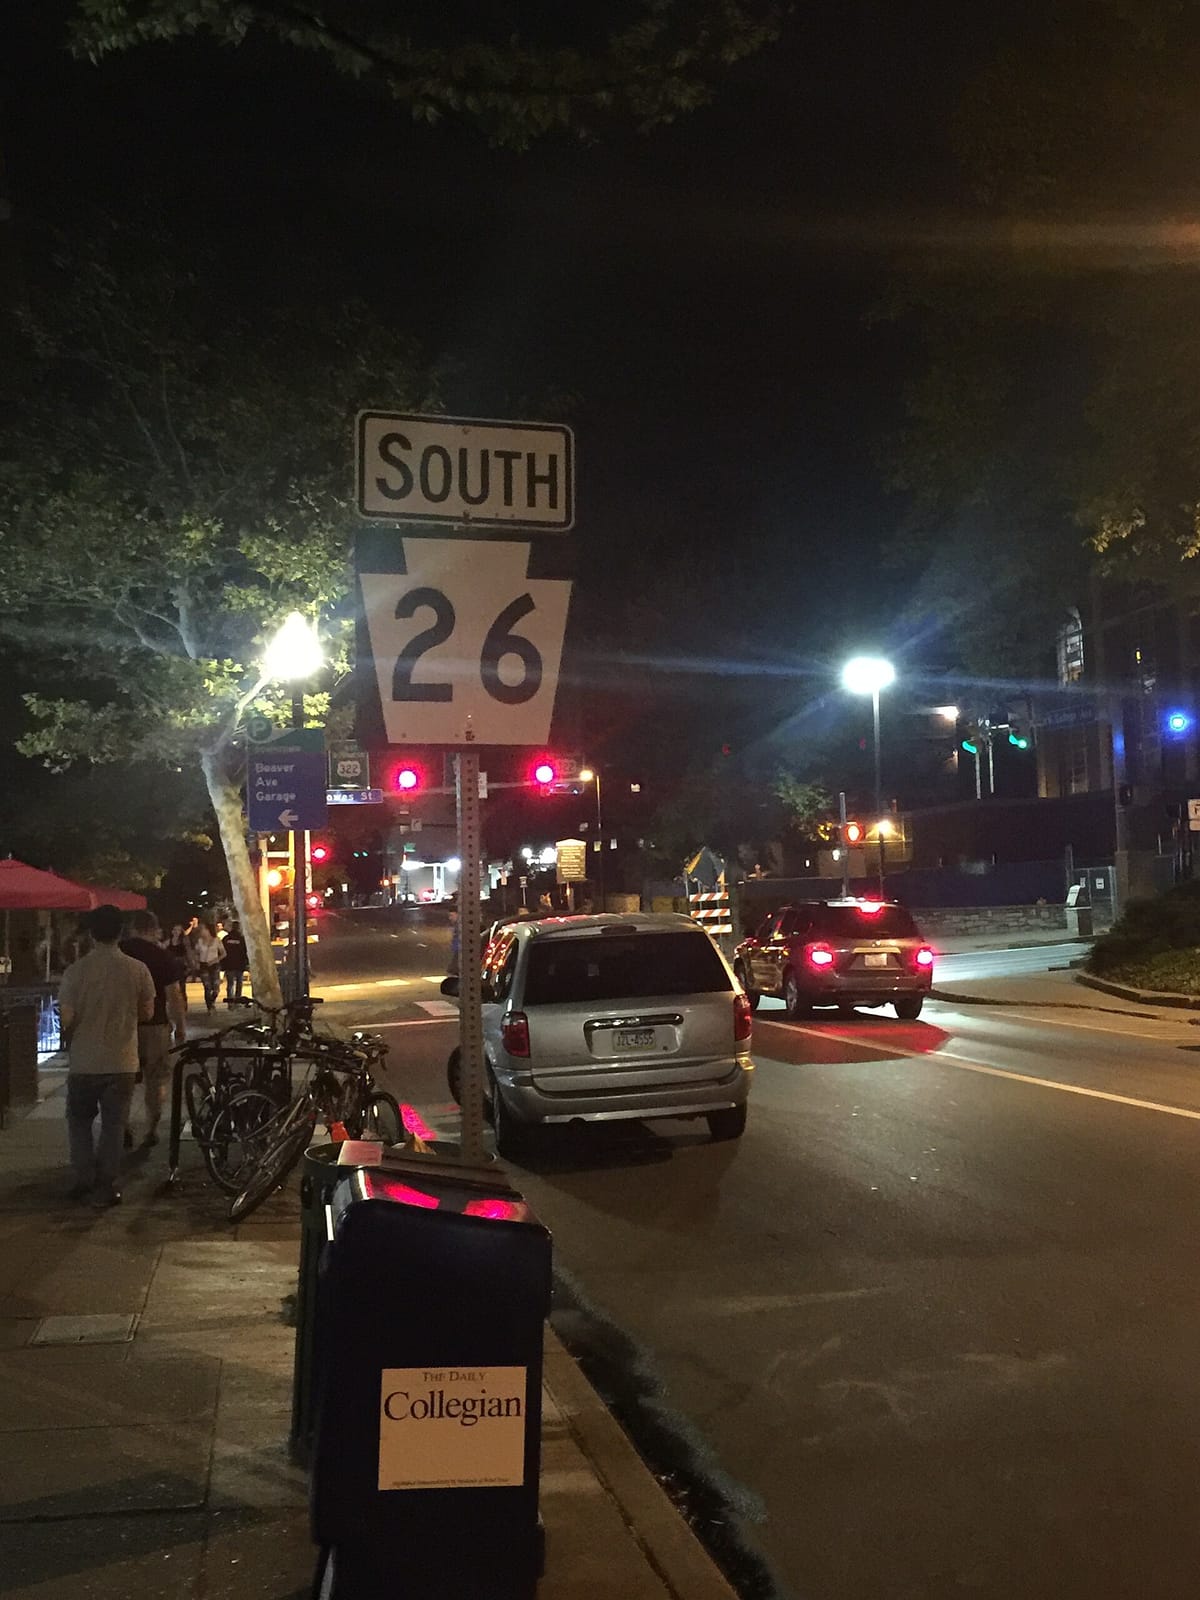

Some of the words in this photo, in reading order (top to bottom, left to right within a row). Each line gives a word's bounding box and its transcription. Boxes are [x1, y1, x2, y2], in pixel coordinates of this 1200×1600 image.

[375, 432, 558, 509] SOUTH
[392, 587, 543, 704] 26
[255, 762, 295, 774] Beaver
[339, 764, 359, 774] 322
[256, 776, 278, 787] Ave
[256, 791, 296, 803] Garage
[361, 792, 372, 801] St
[422, 1371, 446, 1382] THE
[449, 1370, 488, 1381] DAILY
[384, 1389, 521, 1427] Collegian
